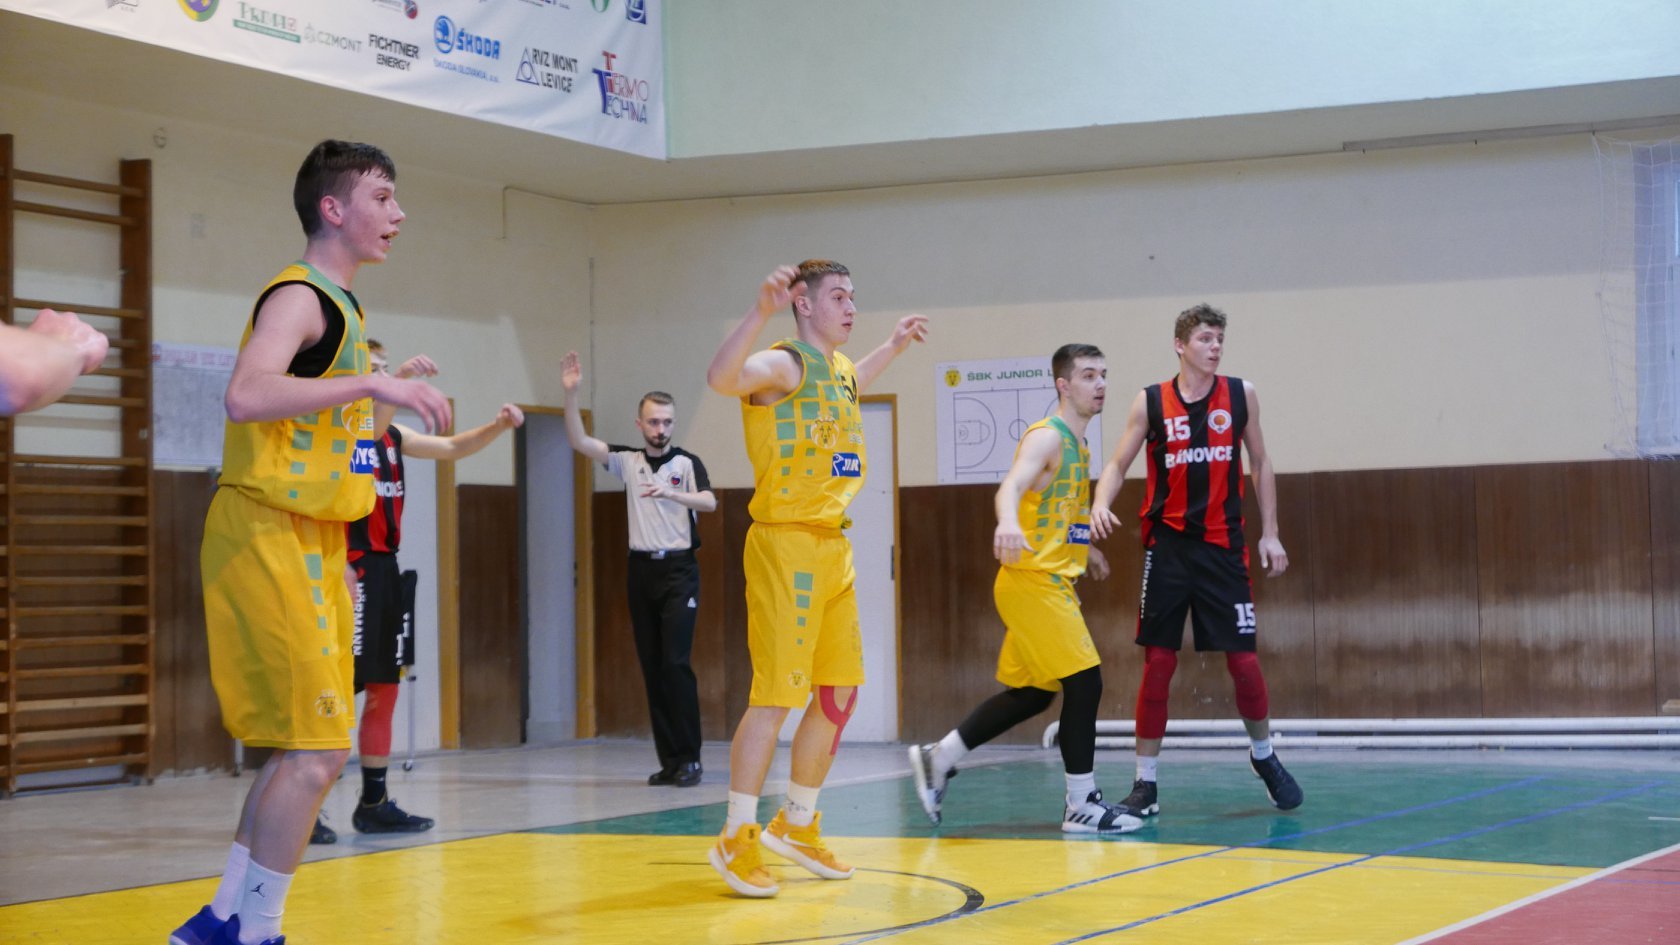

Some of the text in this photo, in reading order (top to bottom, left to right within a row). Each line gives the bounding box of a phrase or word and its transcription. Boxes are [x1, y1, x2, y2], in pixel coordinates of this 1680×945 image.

[368, 33, 420, 60] FICHTNER
[376, 53, 411, 71] ENERGY
[532, 48, 578, 74] RVZ MONT
[541, 71, 573, 93] LEVICE
[996, 368, 1043, 380] JUNIOR
[1164, 415, 1191, 442] 15
[1234, 602, 1256, 627] 15
